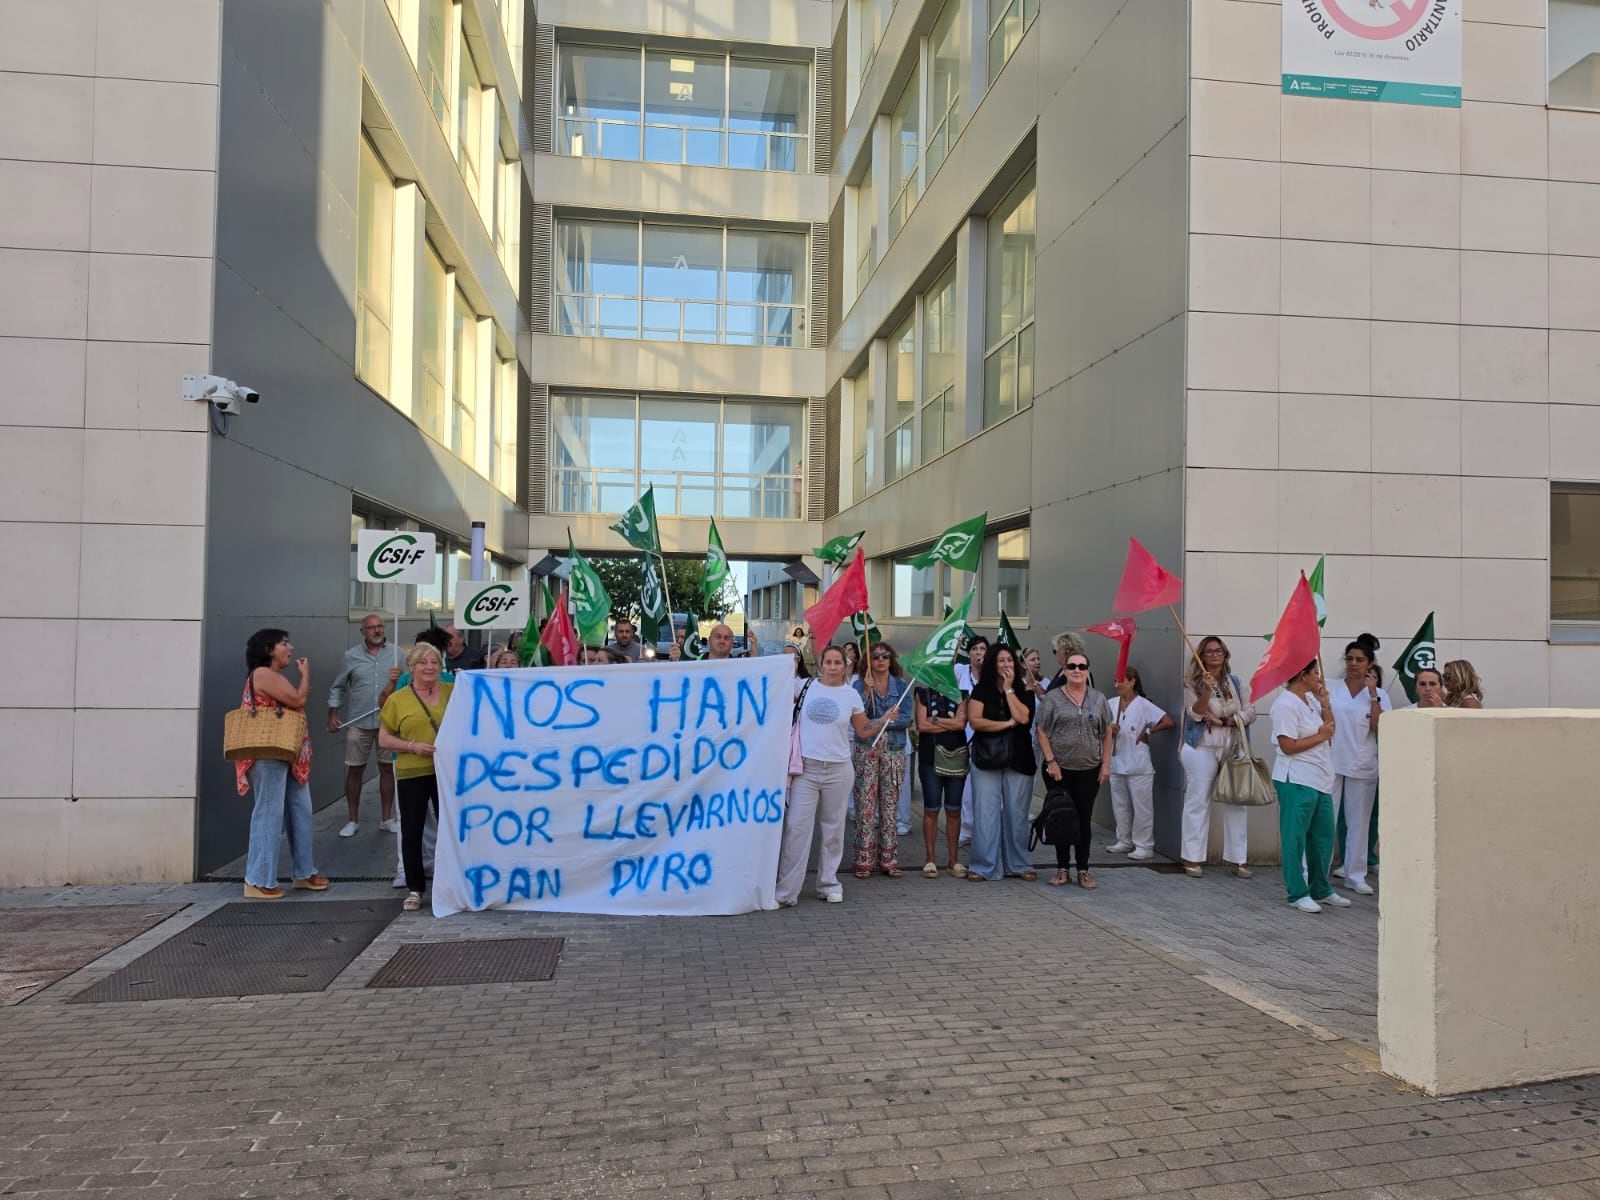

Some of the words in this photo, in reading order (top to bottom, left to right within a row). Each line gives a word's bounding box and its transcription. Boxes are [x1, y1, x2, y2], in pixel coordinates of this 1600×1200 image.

[470, 675, 605, 739] NOS
[649, 676, 768, 733] HAN
[458, 804, 553, 846] POR
[583, 788, 783, 840] LLEVARNOS
[465, 863, 563, 908] PAN
